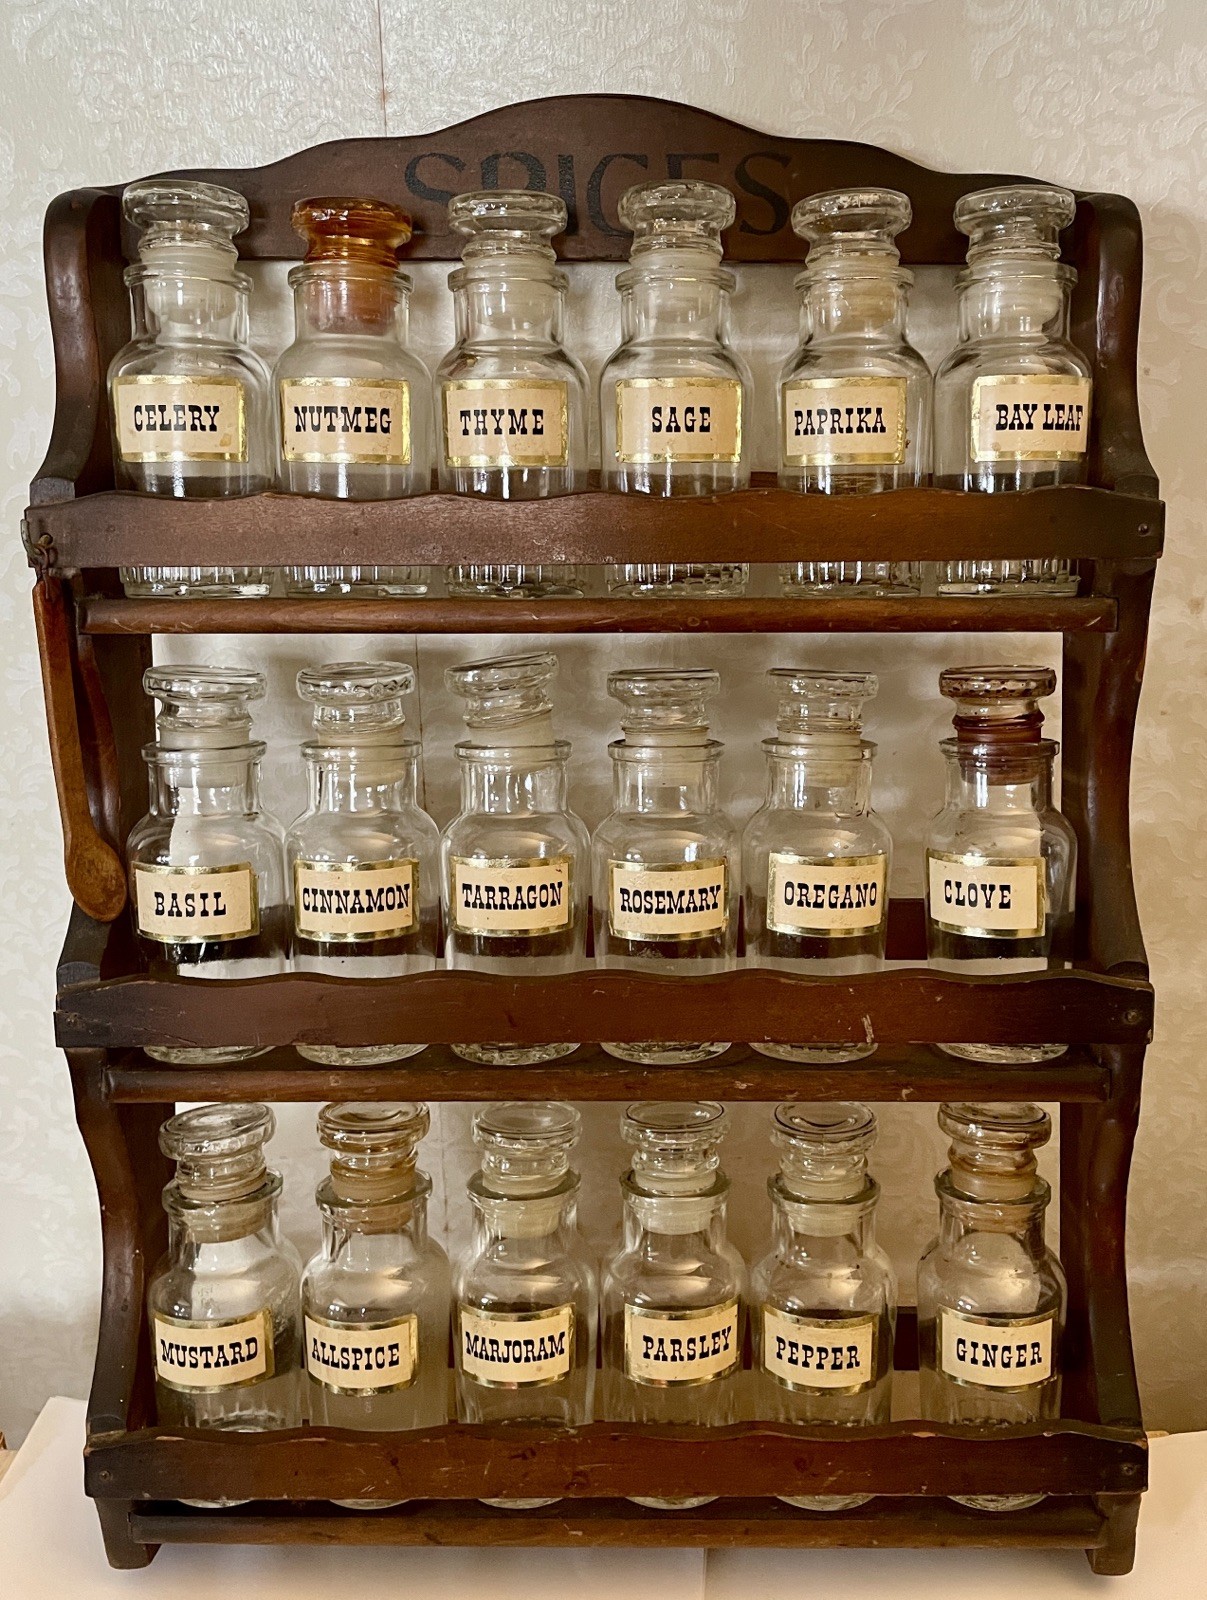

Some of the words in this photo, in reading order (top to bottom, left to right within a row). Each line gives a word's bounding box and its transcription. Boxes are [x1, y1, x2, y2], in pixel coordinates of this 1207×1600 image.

[134, 405, 219, 431] CELERY
[294, 406, 391, 434] NUTMEG
[460, 409, 543, 435] THYME
[652, 407, 710, 432] SAGE
[795, 408, 886, 436] PAPRIKA
[995, 403, 1038, 431] BAY
[1042, 403, 1084, 431] LEAF
[155, 892, 226, 917] BASIL
[303, 884, 410, 914] CINNAMON
[462, 881, 562, 910] TARRAGON
[620, 885, 721, 914] ROSEMARY
[785, 882, 877, 909] OREGANO
[945, 880, 1010, 909] CLOVE
[160, 1337, 258, 1369] MUSTARD
[310, 1338, 400, 1371] ALLSPICE
[465, 1331, 566, 1365] MARJORAM
[643, 1326, 731, 1362] PARSLEY
[776, 1336, 860, 1370] PEPPER
[957, 1338, 1042, 1368] GINGER
